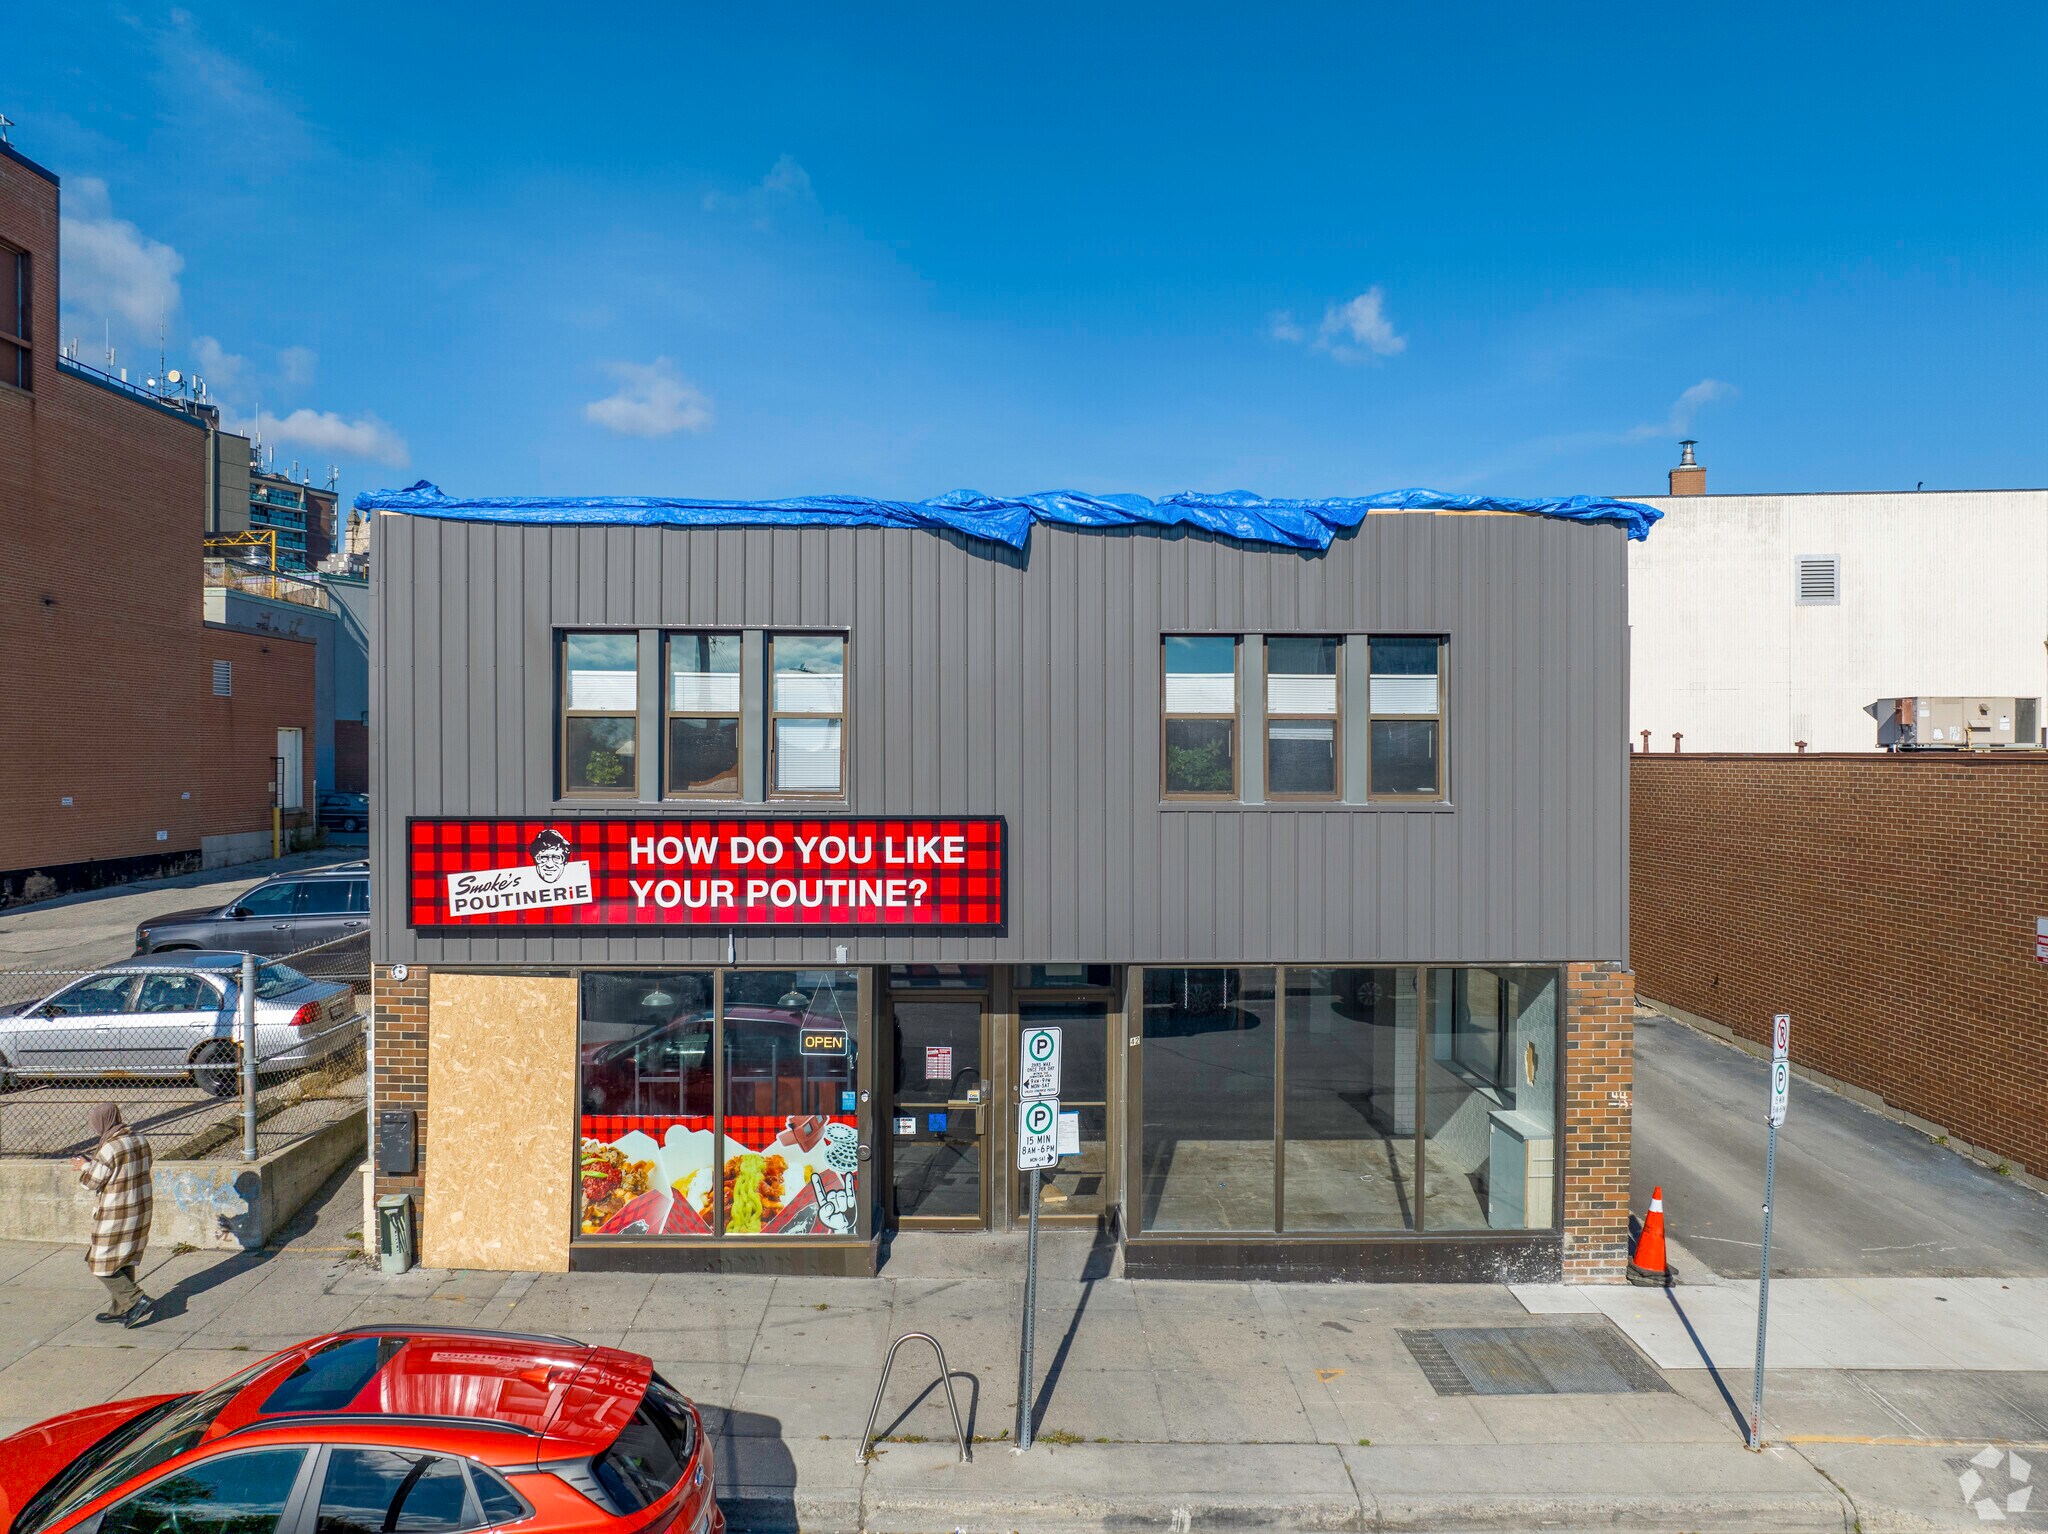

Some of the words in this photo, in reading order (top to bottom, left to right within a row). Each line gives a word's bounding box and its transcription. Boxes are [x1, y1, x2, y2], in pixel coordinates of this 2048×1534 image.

[630, 836, 718, 865] HOW
[731, 836, 784, 864] DO
[793, 836, 872, 864] YOU
[885, 836, 965, 864] LIKE
[455, 873, 522, 896] Smoke's
[629, 879, 735, 908] YOUR
[747, 878, 928, 908] POUTINE?
[805, 1036, 843, 1048] OPEN
[1037, 1039, 1047, 1054] P
[1778, 1071, 1784, 1087] P
[1034, 1110, 1046, 1127] P
[1027, 1136, 1034, 1145] 15
[1037, 1135, 1051, 1144] MIN
